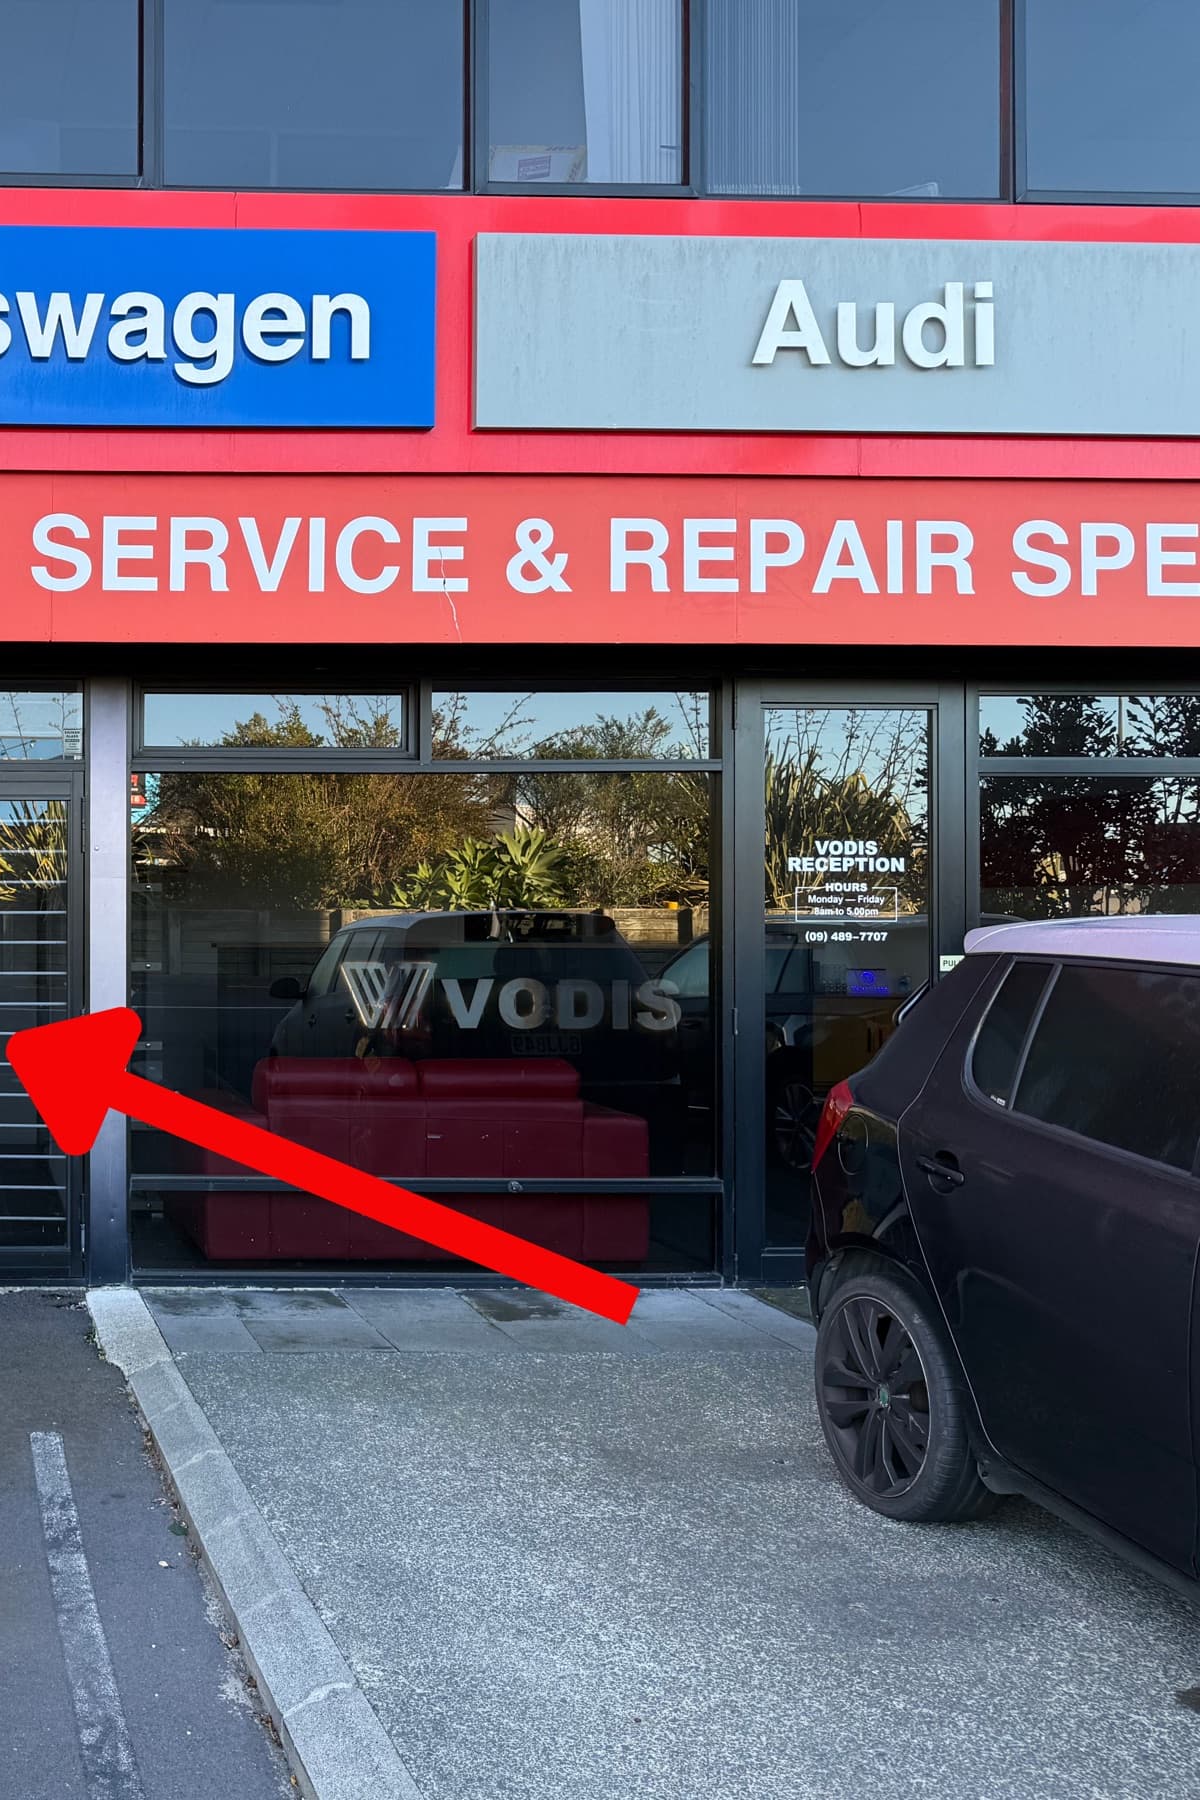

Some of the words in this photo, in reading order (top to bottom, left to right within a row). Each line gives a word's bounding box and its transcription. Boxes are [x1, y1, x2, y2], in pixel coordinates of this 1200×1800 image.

[751, 279, 995, 368] Audi
[31, 513, 468, 595] SERVICE
[506, 517, 573, 594] &
[610, 517, 976, 595] REPAIR
[1011, 519, 1200, 598] SPE
[815, 840, 878, 855] VODIS
[788, 857, 905, 872] RECEPTION
[825, 882, 868, 892] HOURS
[808, 894, 844, 905] Monday
[857, 894, 885, 905] Friday
[814, 907, 835, 916] 8am
[837, 907, 845, 916] to
[846, 907, 879, 918] 5.00pm
[805, 931, 828, 943] (09)
[442, 977, 682, 1031] VODIS
